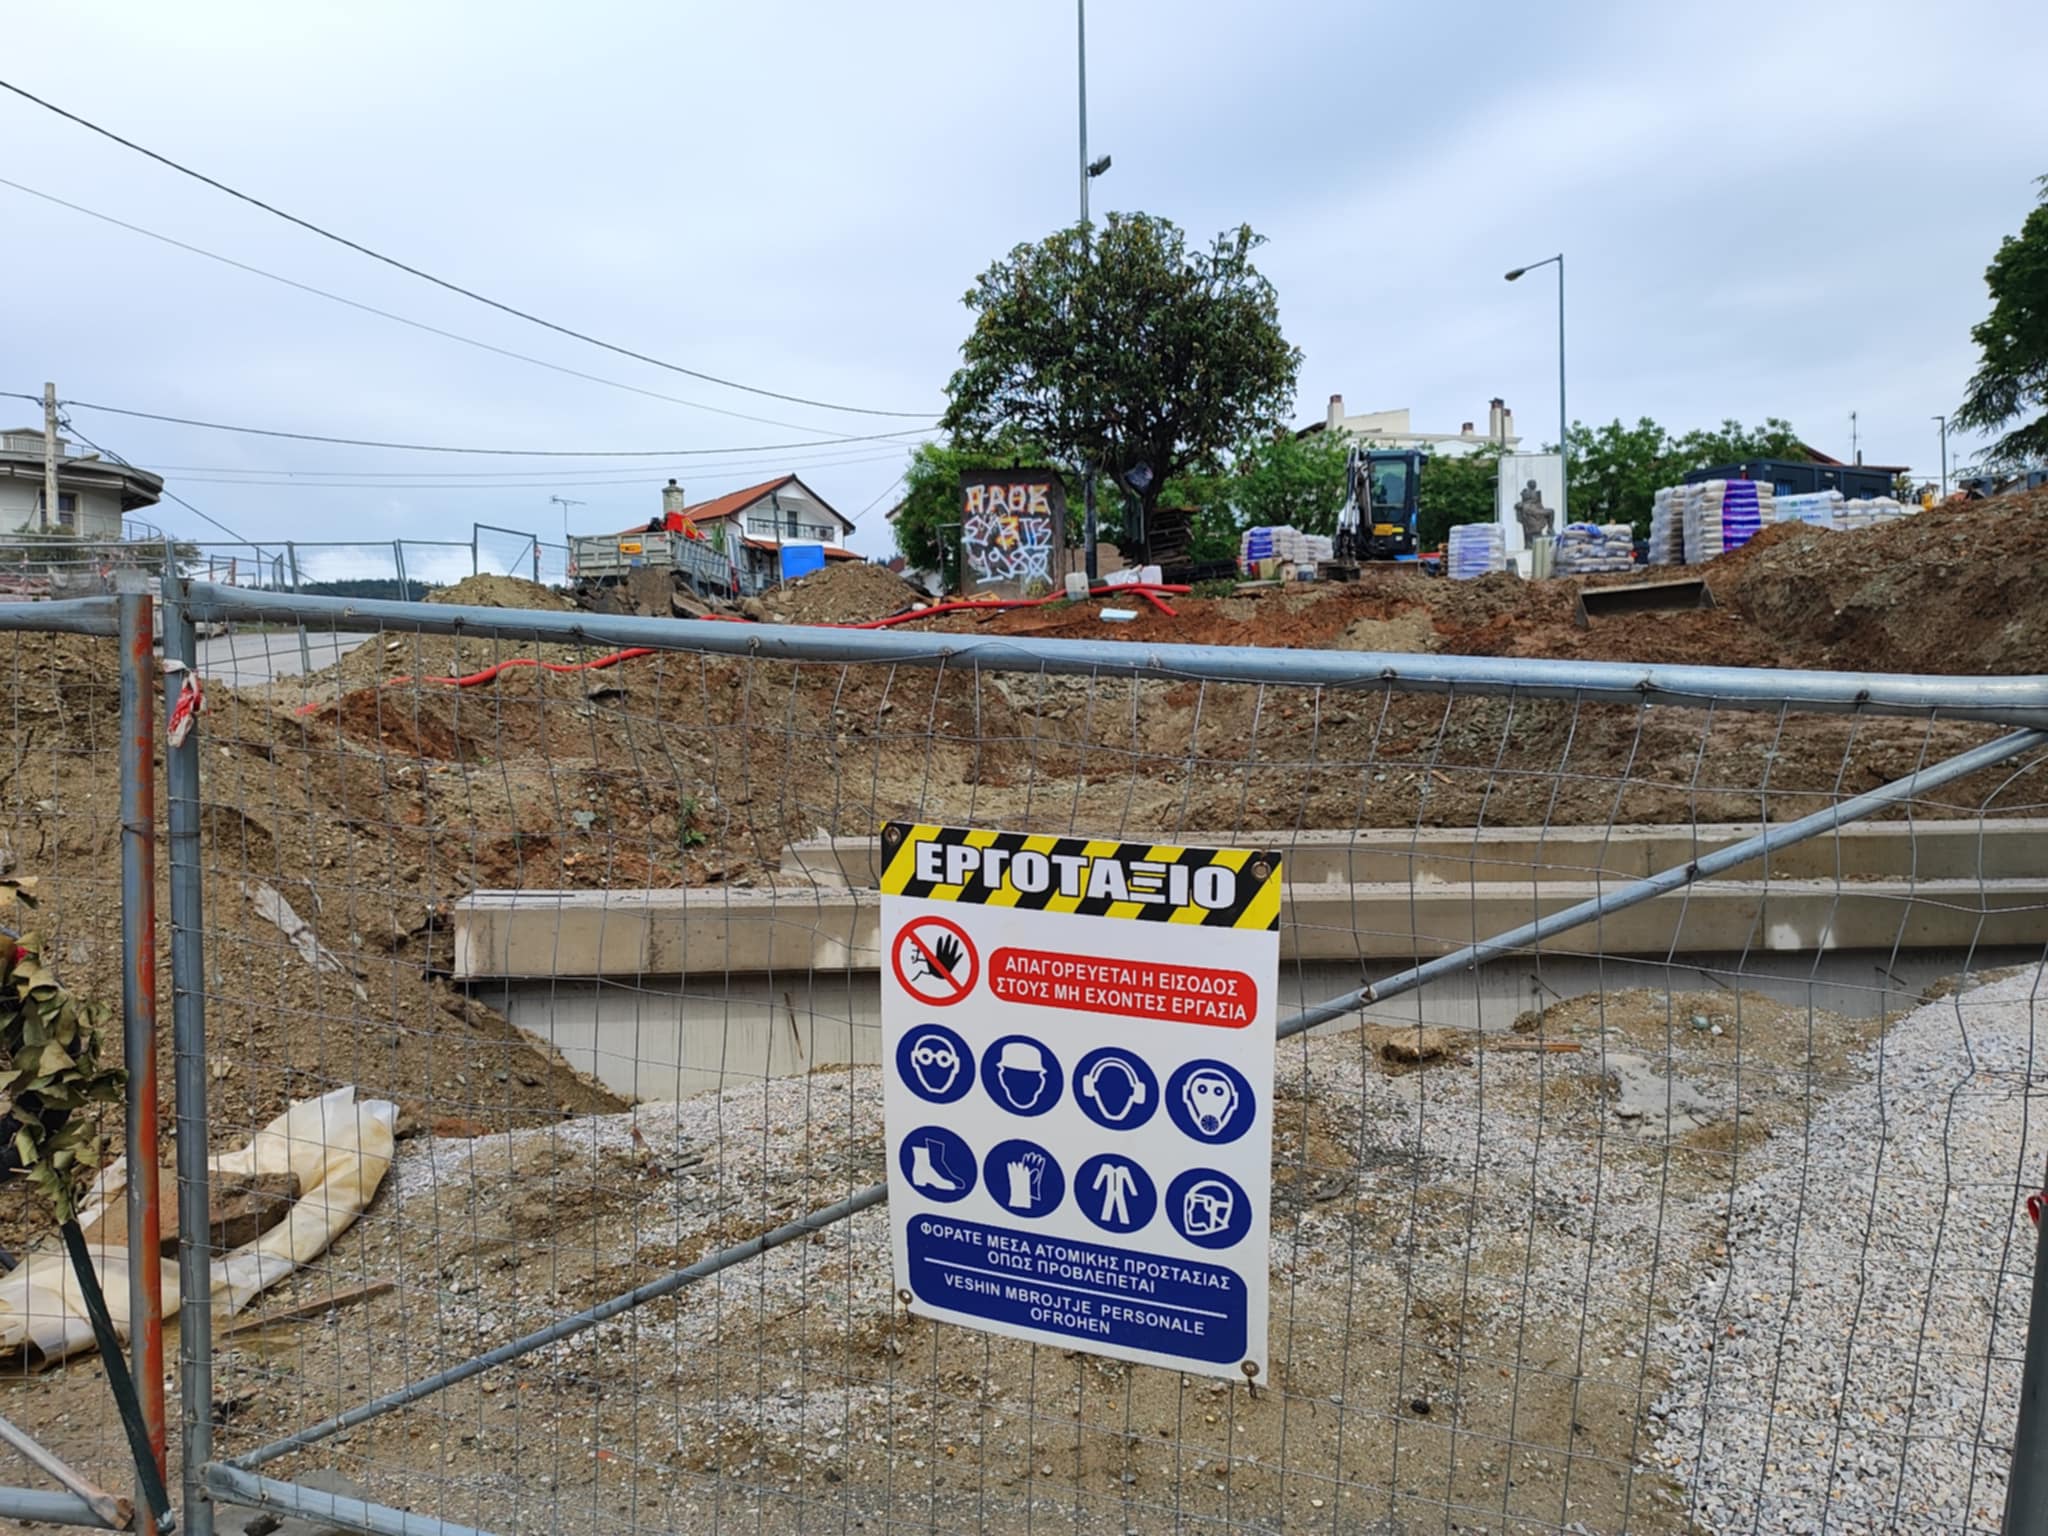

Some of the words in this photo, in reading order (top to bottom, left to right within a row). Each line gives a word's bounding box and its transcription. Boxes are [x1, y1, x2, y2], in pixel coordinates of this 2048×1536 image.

[915, 841, 1237, 909] ΕΡΓΟΤΑΞΙΟ
[996, 976, 1049, 998] ΣΤΟΥΣ
[1054, 984, 1080, 1001] ΜΗ
[1085, 987, 1167, 1012] ΕΧΟΝΤΕΣ
[1172, 997, 1247, 1021] ΕΡΓΑΣΙΑ
[1005, 956, 1137, 986] ΑΠΑΓΟΡΕΥΕΤΑΙ
[1142, 972, 1154, 987] Η
[1159, 973, 1238, 997] ΕΙΣΟΔΟΣ
[920, 1222, 982, 1245] ΦΟΡΑΤΕ
[987, 1234, 1031, 1254] ΜΕΣΑ
[1035, 1244, 1119, 1271] ΑΤΟΜΙΚΗΣ
[1124, 1260, 1231, 1291] ΠΡΟΣΤΑΣΙΑΣ
[988, 1251, 1033, 1271] ΟΠΩΣ
[1037, 1261, 1155, 1294] ΠΡΟΒΛΕΠΕΤΑΙ
[944, 1273, 1000, 1296] VESHIN
[1005, 1286, 1091, 1315] MBROJTJE
[1101, 1304, 1205, 1335] PERSONALE
[1031, 1307, 1111, 1334] OFROHEN
